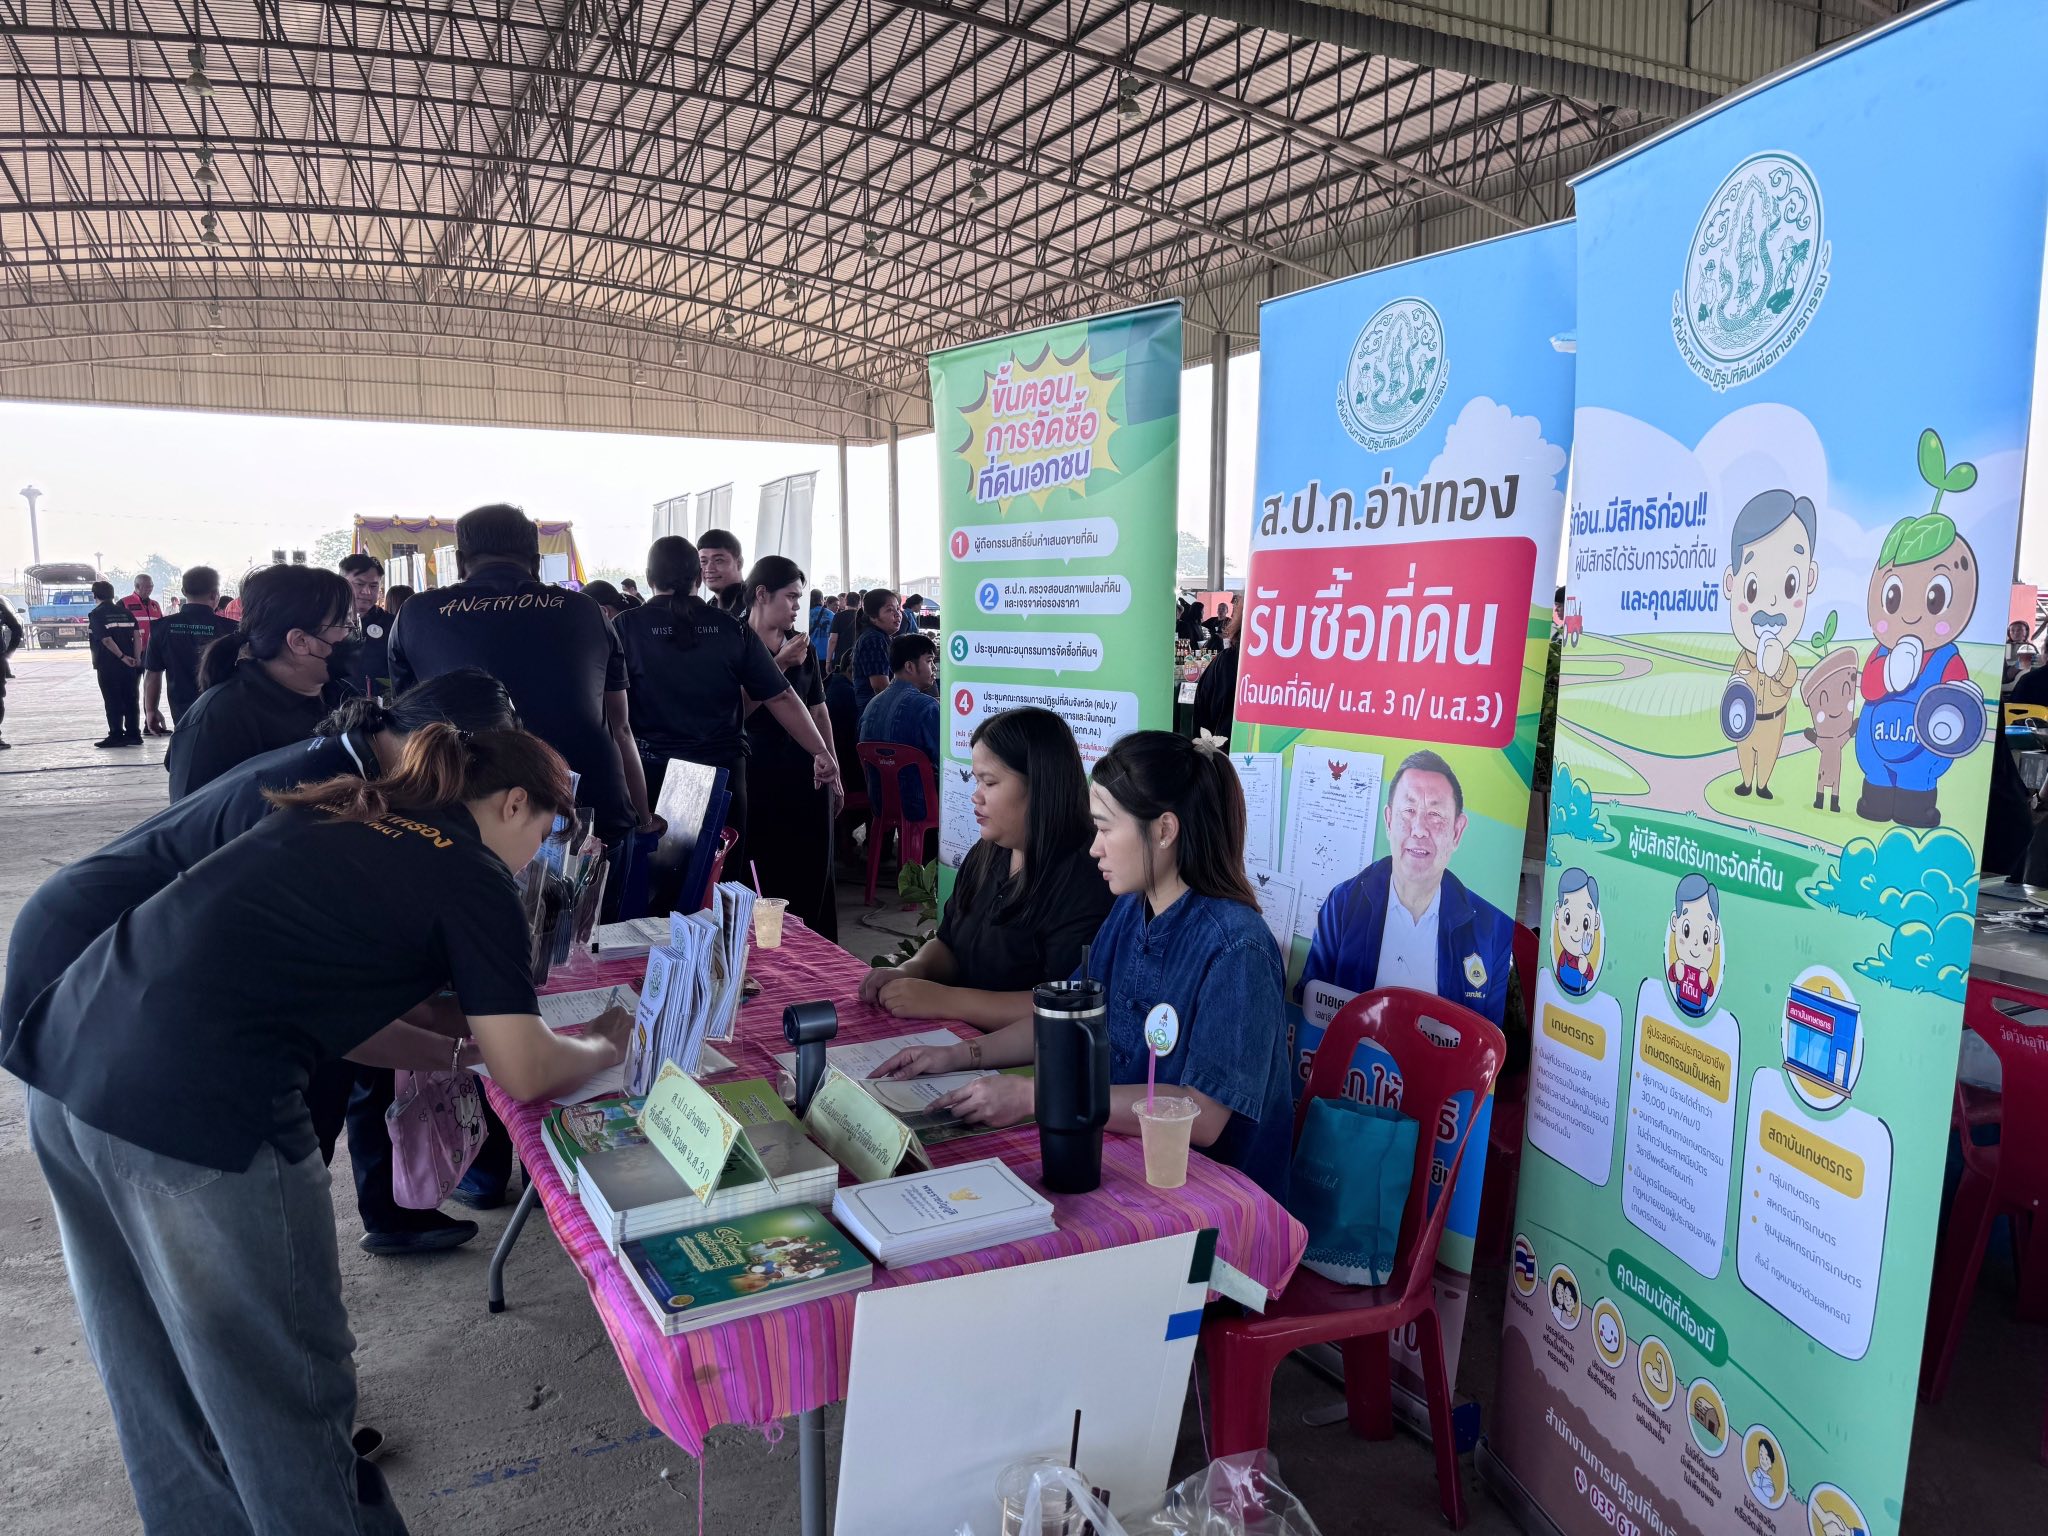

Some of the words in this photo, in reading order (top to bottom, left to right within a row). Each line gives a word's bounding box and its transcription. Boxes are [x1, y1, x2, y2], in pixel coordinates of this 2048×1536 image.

[991, 363, 1074, 414] ขั้นตอน
[985, 391, 1097, 453] การจัดซื้อ
[978, 449, 1091, 501] ที่ดินเอกชน
[1261, 471, 1520, 537] ส.ป.ก.อ่างทอง
[955, 535, 963, 554] 1
[974, 528, 1098, 553] ผู้ถือกรรมสิทธิ์ยื่นคำเสนอขายที่ดิน
[1575, 534, 1717, 580] ผู้มีสิทธิได้รับการจัดที่ดิน
[984, 586, 995, 606] 2
[1247, 562, 1499, 666] รับซื้อที่ดิน
[1620, 581, 1720, 620] และคุณสมบัติ
[954, 640, 964, 658] 3
[959, 693, 970, 712] 4
[1239, 672, 1335, 713] (โฉนดที่ดิน/
[1339, 689, 1375, 713] น.ส.
[1384, 690, 1395, 716] 3
[1430, 691, 1503, 728] น.ส.3)
[1628, 824, 1784, 892] ผู้มีสิทธิได้รับการจัดที่ดิน
[1551, 1017, 1595, 1046] เกษตรกร
[1646, 1024, 1725, 1071] ผู้ประสงค์จะประกอบอาชีพ
[1644, 1043, 1721, 1091] เกษตรกรรมเป็นหลัก
[1641, 1090, 1666, 1111] 30,000
[1768, 1127, 1854, 1182] สถาบันเกษตรกร
[1768, 1171, 1821, 1210] กลุ่มเกษตรกร
[1766, 1197, 1837, 1247] สหกรณ์การเกษตร
[1764, 1222, 1863, 1289] ชุมนุมสหกรณ์การเกษตร
[1616, 1263, 1717, 1354] คุณสมบัติที่ต้องมี
[1590, 1484, 1616, 1524] 035
